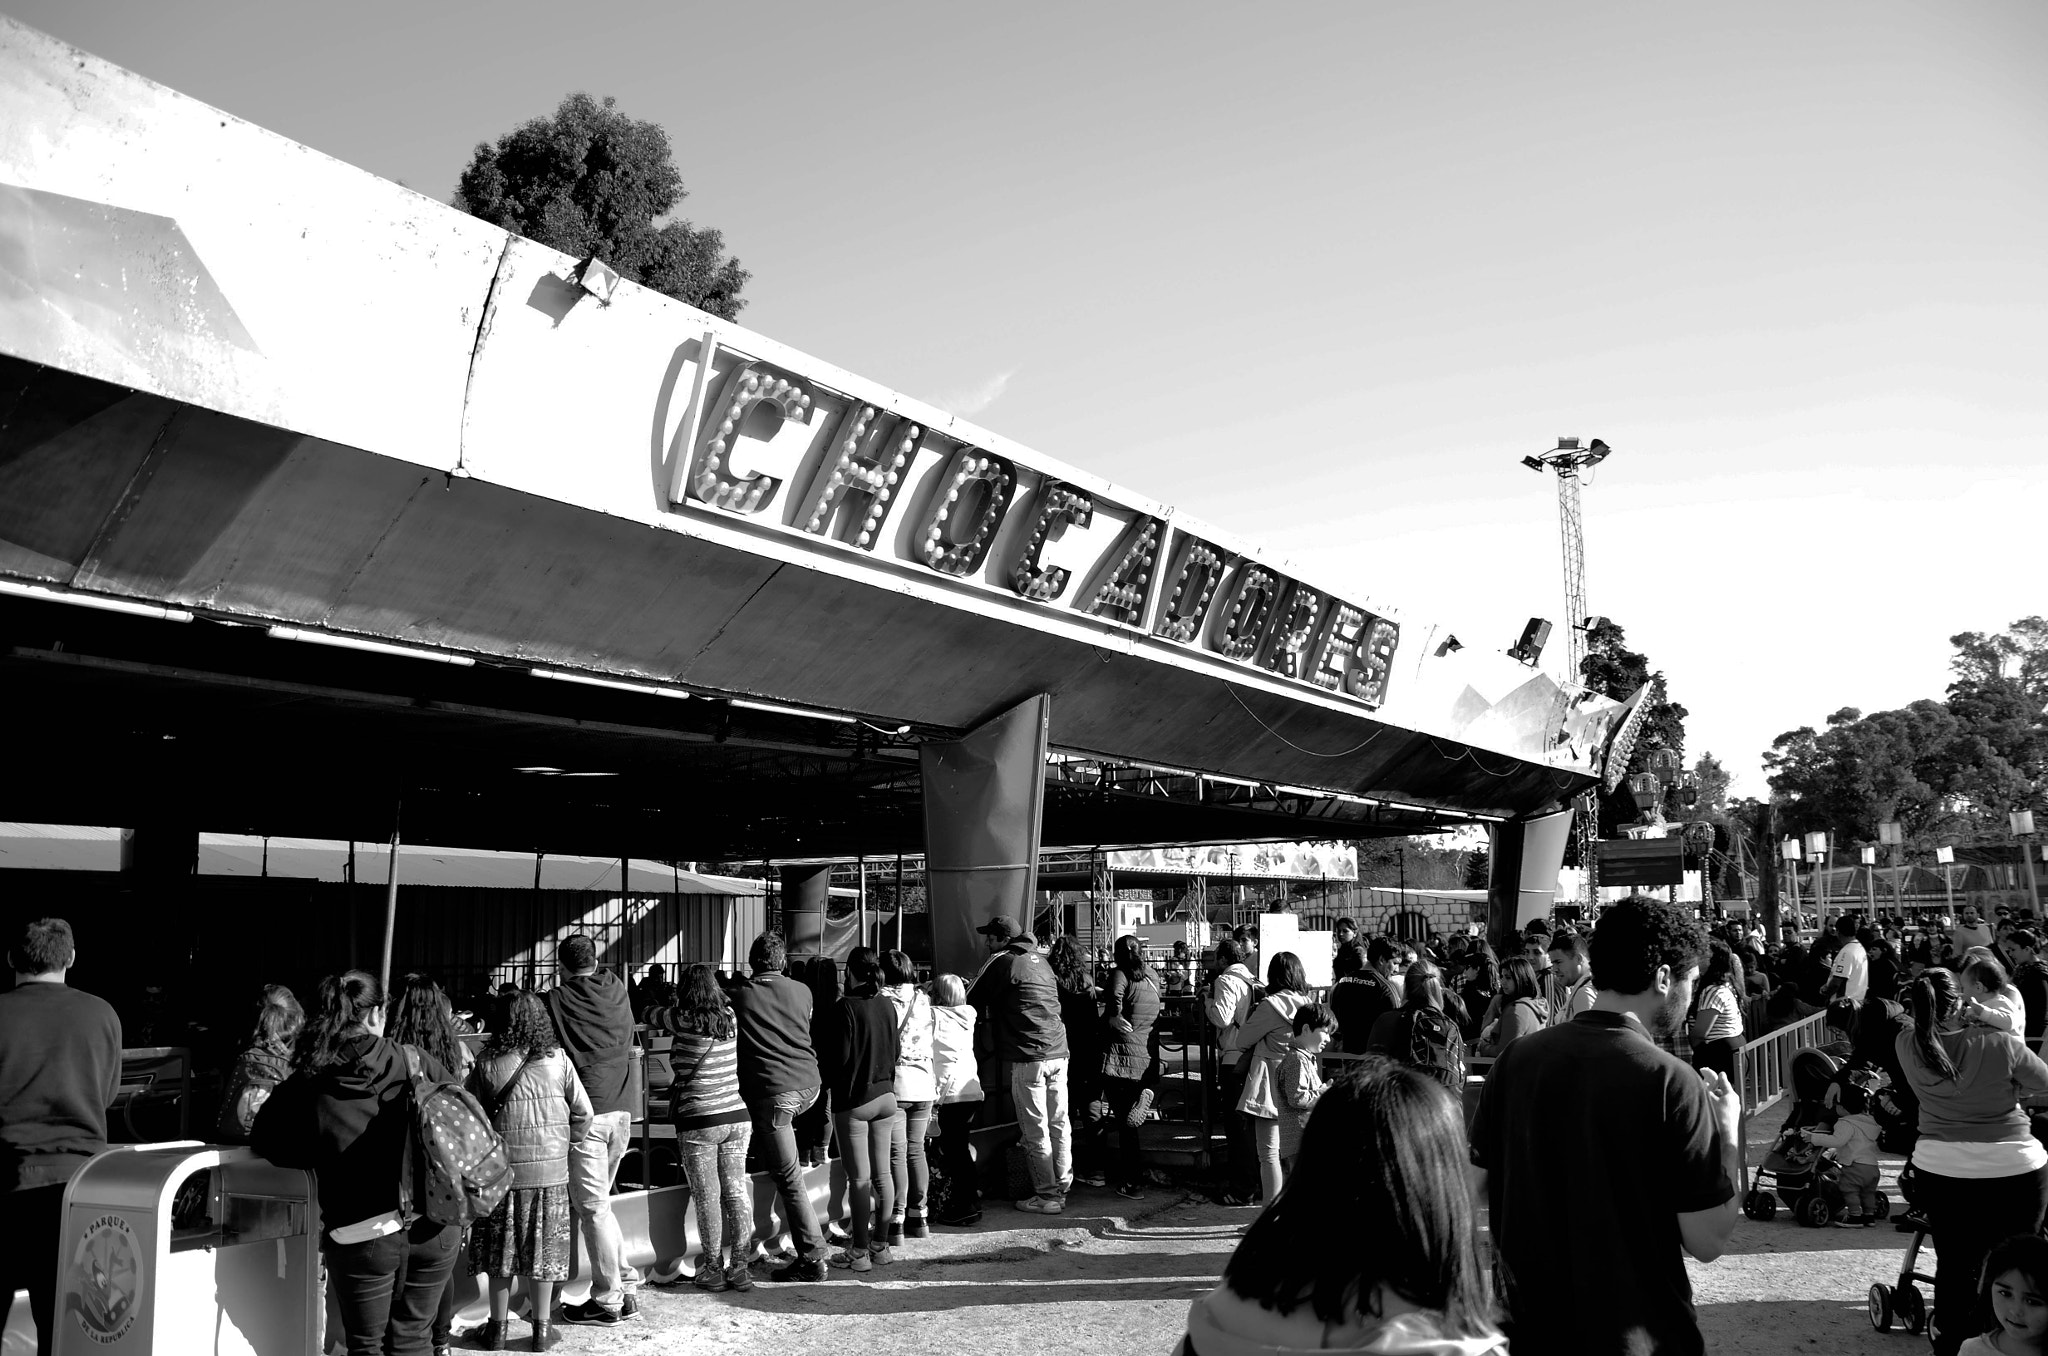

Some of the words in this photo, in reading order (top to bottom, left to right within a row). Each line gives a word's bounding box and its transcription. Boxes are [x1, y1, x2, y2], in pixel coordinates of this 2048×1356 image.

[694, 360, 1400, 703] CHOCADORES
[89, 1215, 126, 1234] PARQUE
[82, 1320, 90, 1333] DE
[90, 1330, 99, 1342] LA
